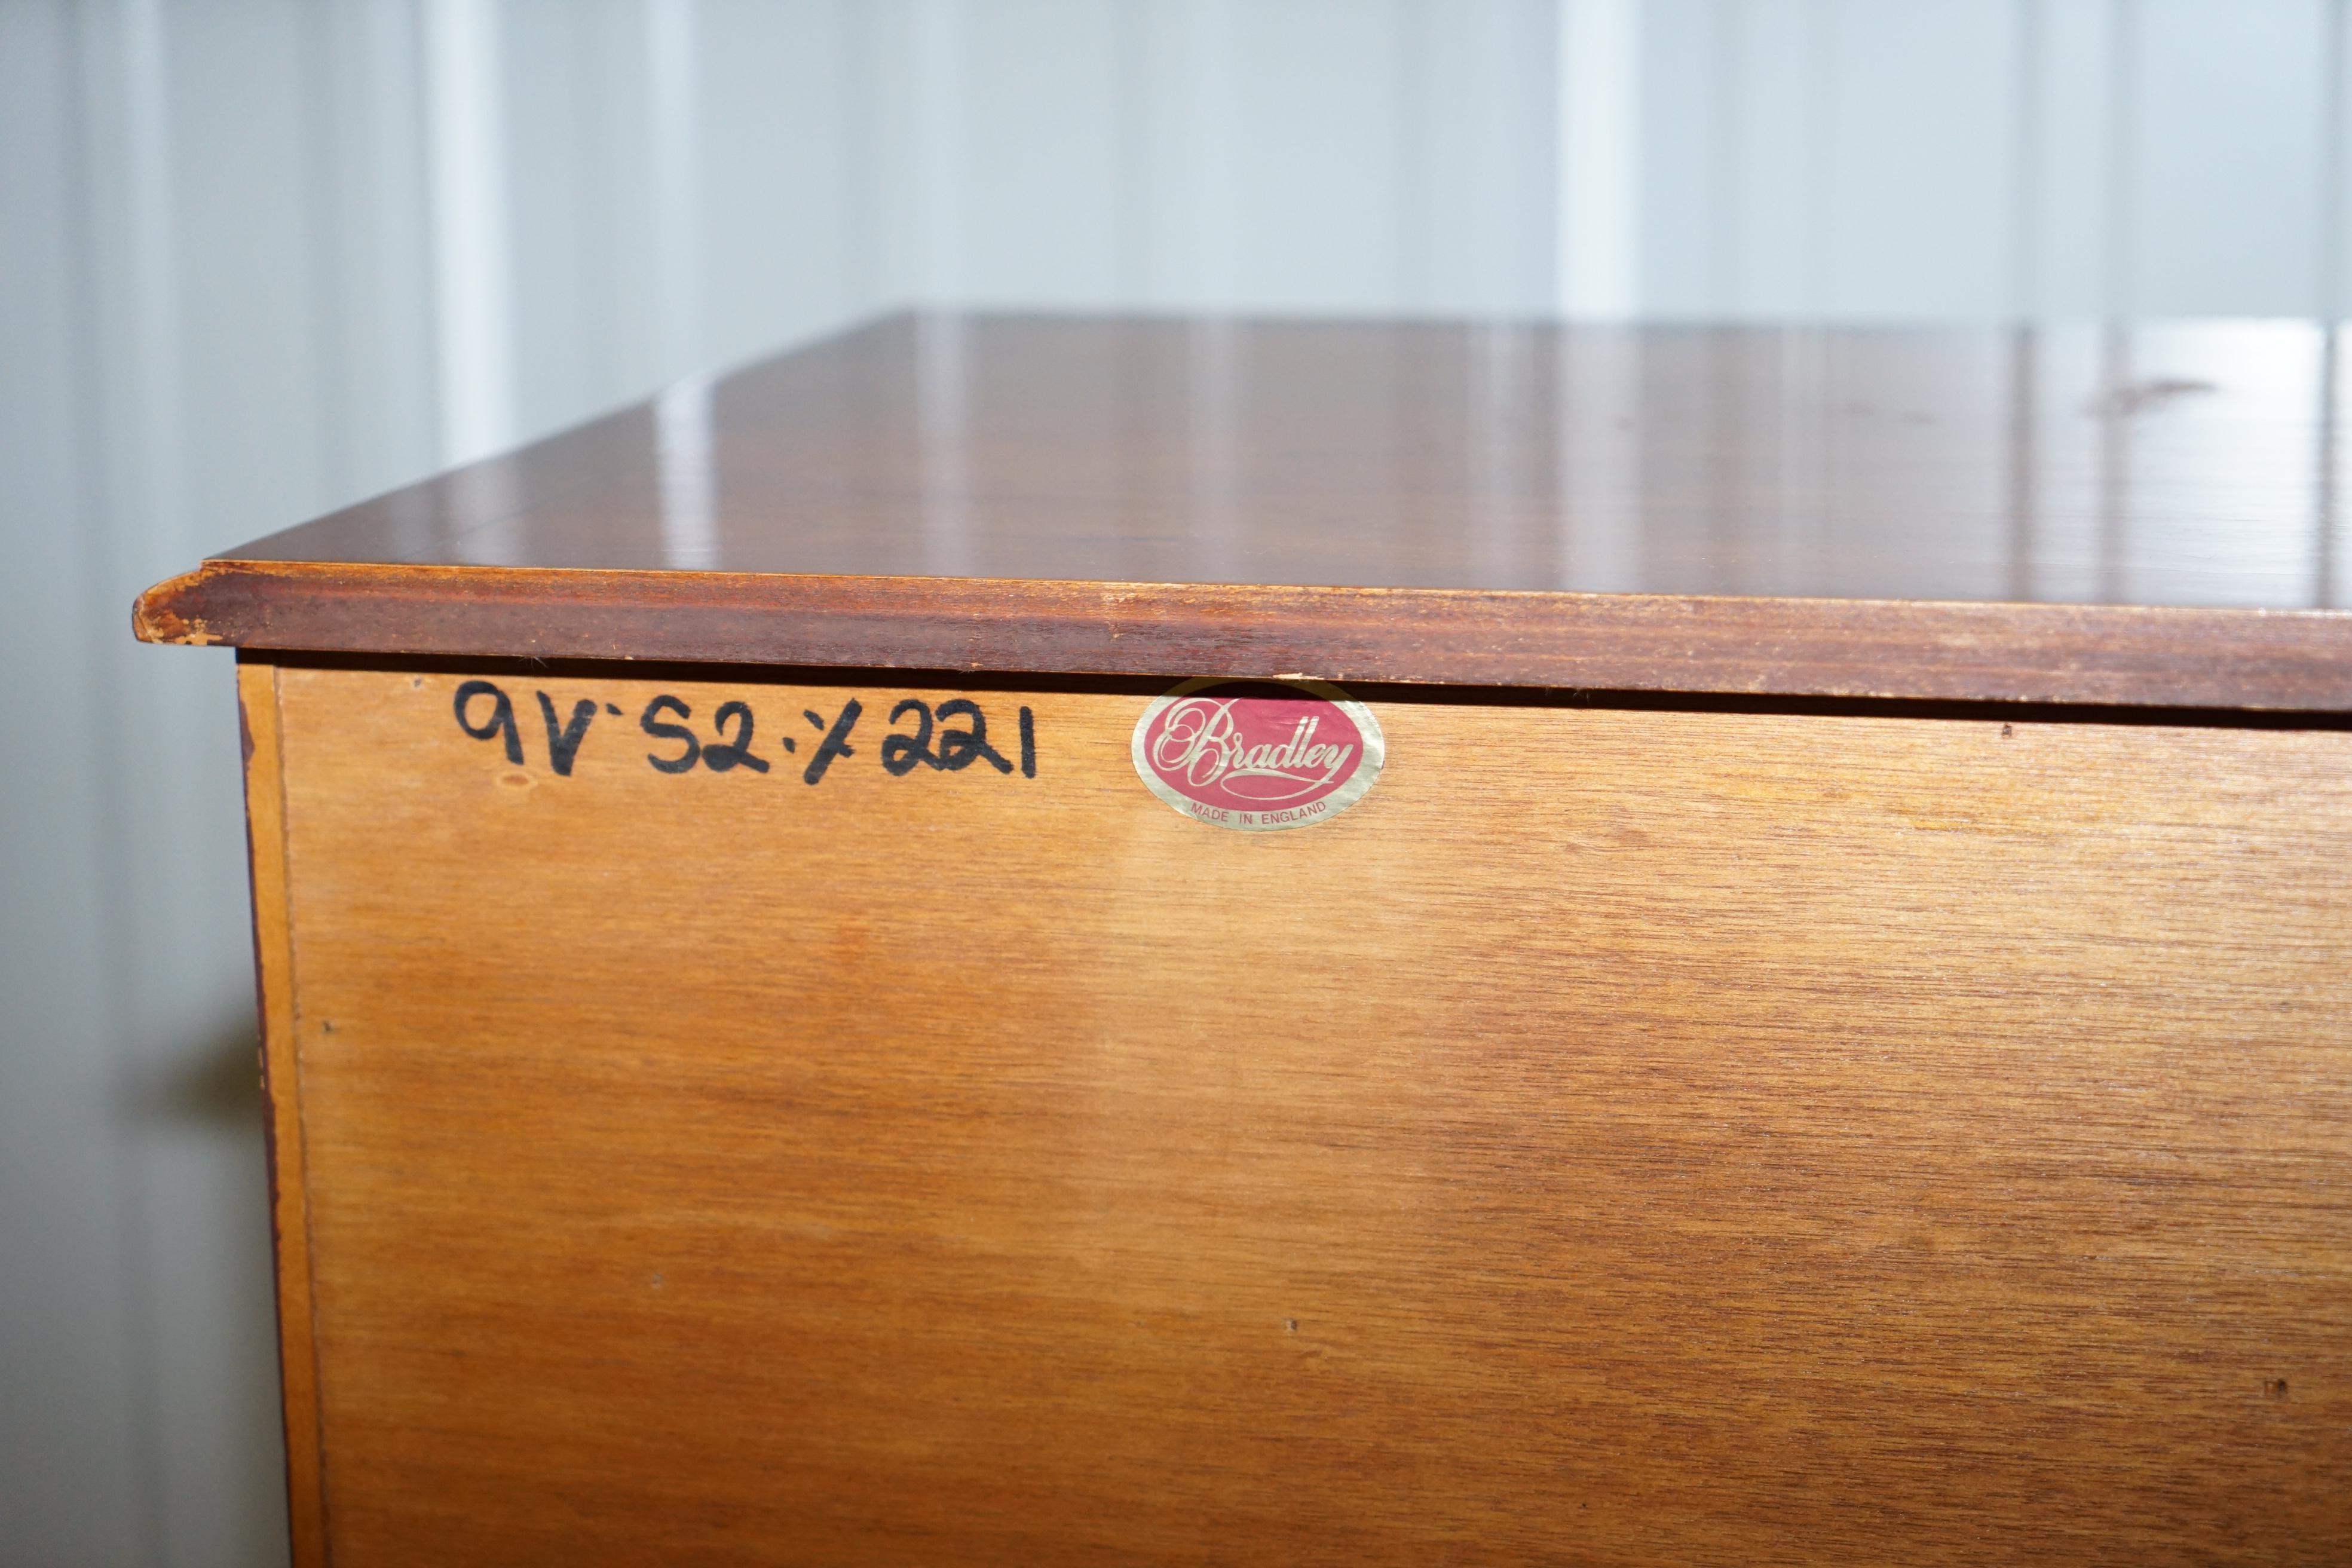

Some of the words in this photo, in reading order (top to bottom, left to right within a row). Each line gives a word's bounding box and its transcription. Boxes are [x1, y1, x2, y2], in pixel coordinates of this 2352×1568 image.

[1152, 697, 1355, 801] Bradley
[1190, 802, 1229, 822] MADE
[1239, 813, 1253, 825] IN
[1261, 801, 1326, 825] ENGLAND
